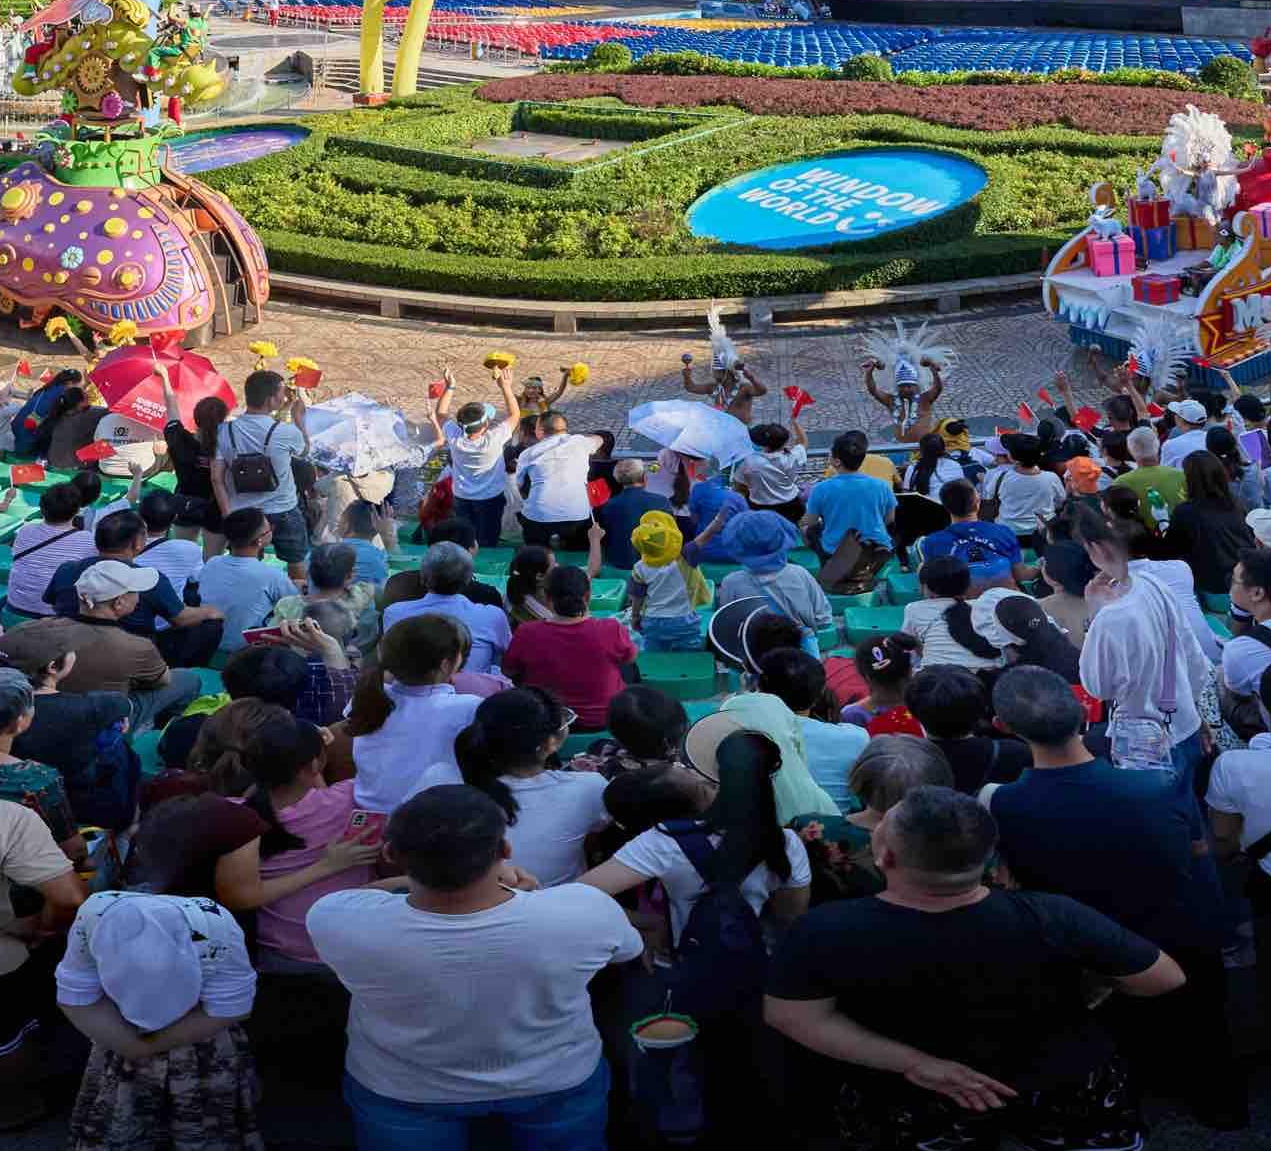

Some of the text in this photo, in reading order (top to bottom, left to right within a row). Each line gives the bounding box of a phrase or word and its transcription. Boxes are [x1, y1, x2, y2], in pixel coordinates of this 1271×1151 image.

[738, 187, 839, 225] WORLD
[769, 178, 862, 211] OF THE
[796, 167, 947, 216] WINDOW
